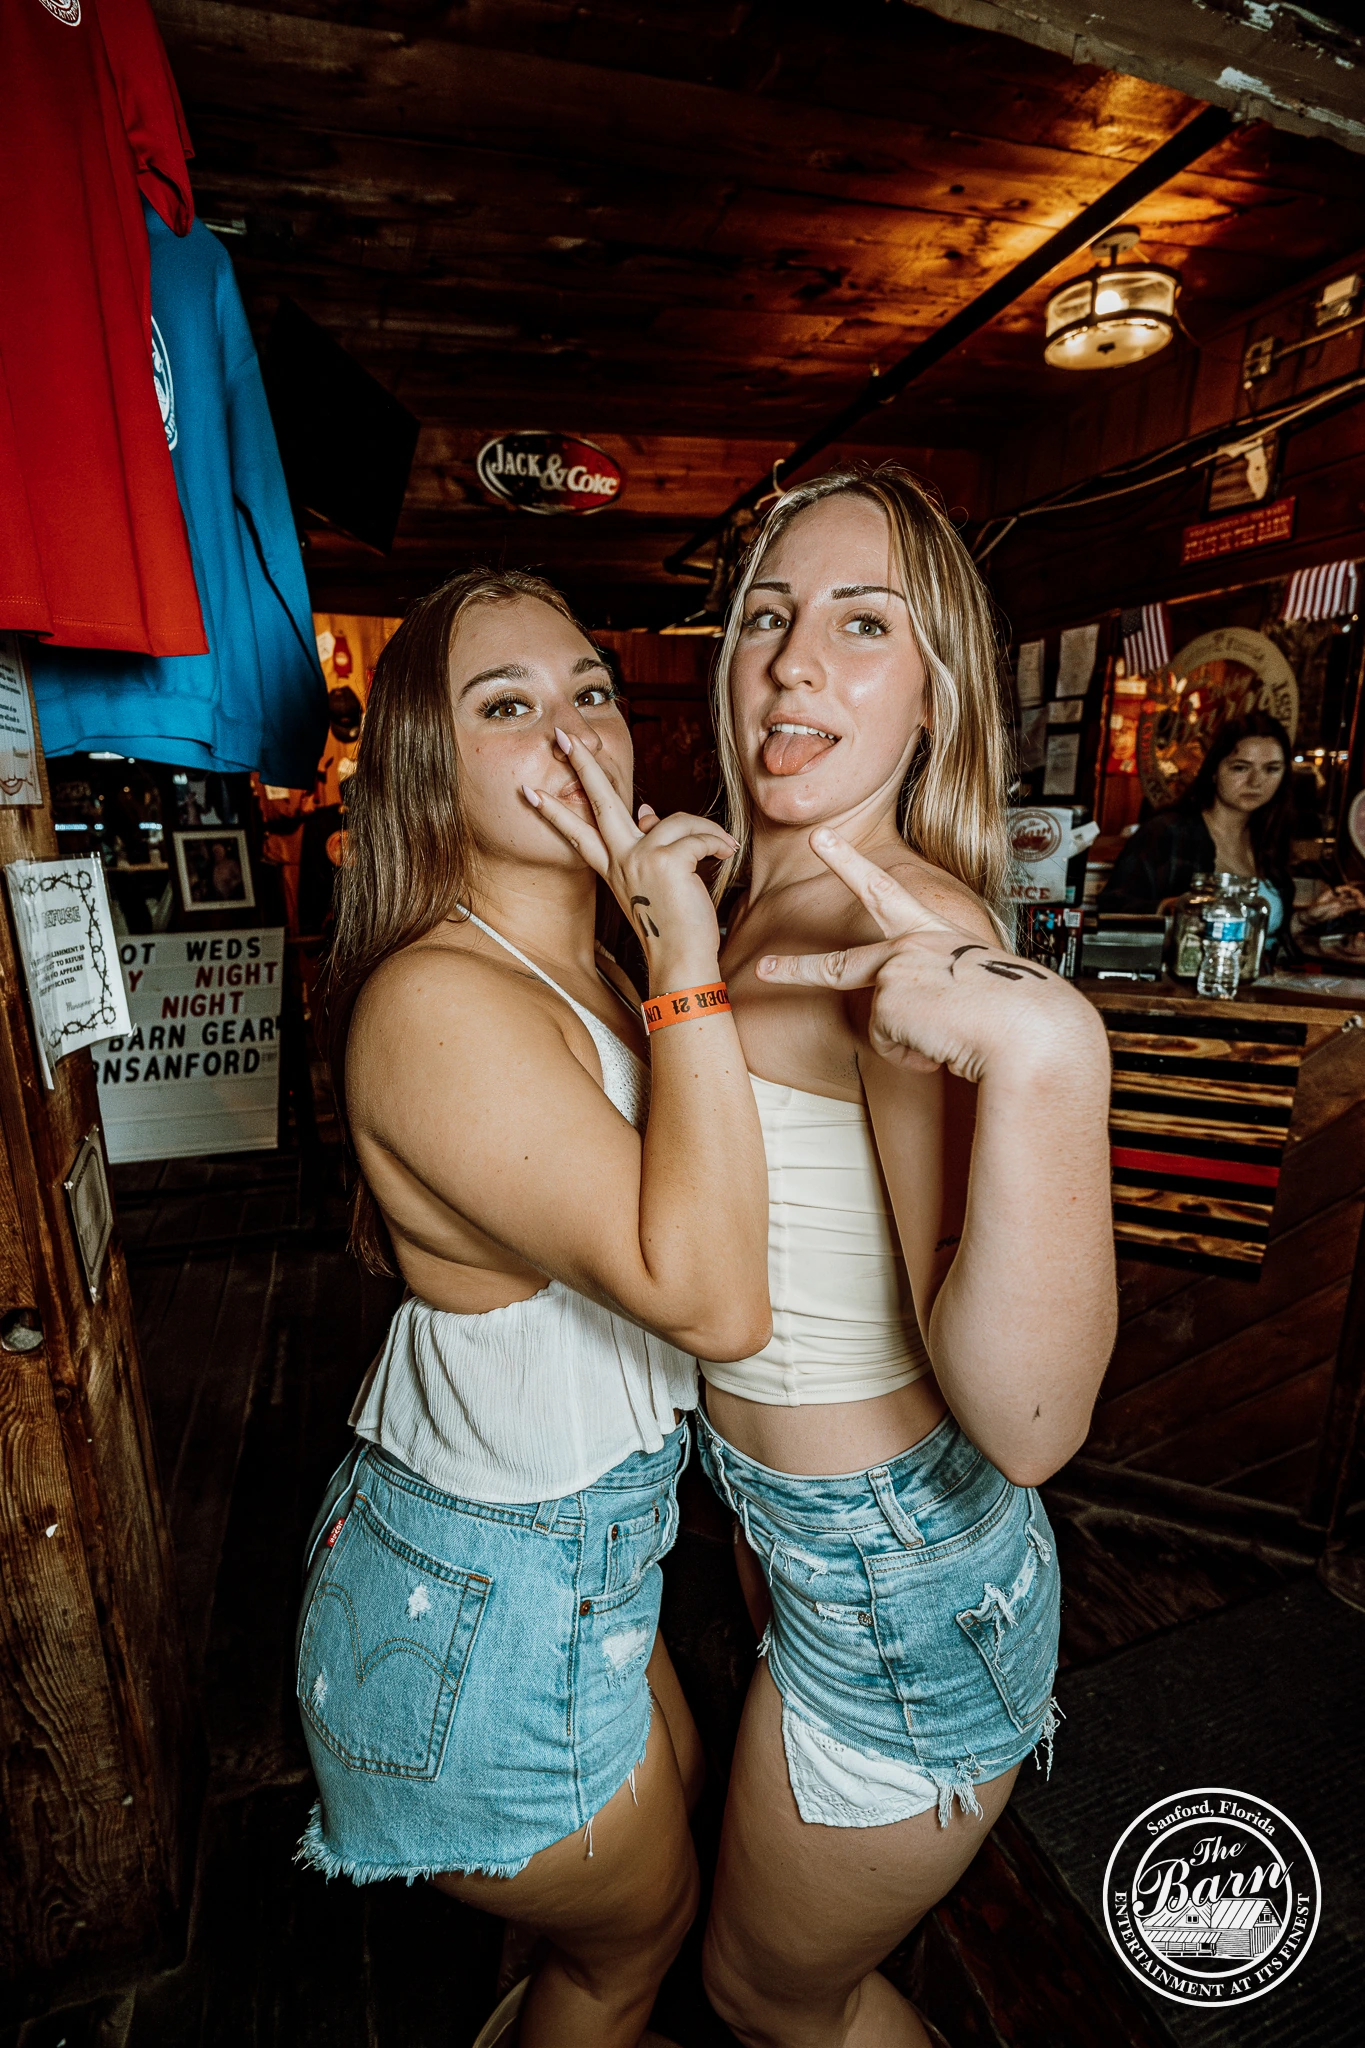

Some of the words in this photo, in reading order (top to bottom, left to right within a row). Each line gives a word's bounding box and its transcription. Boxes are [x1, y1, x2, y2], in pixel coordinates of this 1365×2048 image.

[186, 936, 261, 962] WEDS
[128, 969, 144, 992] Y
[195, 962, 278, 988] NIGHT
[161, 991, 244, 1019] NIGHT
[671, 997, 690, 1015] 21
[202, 1017, 275, 1045] GEAR
